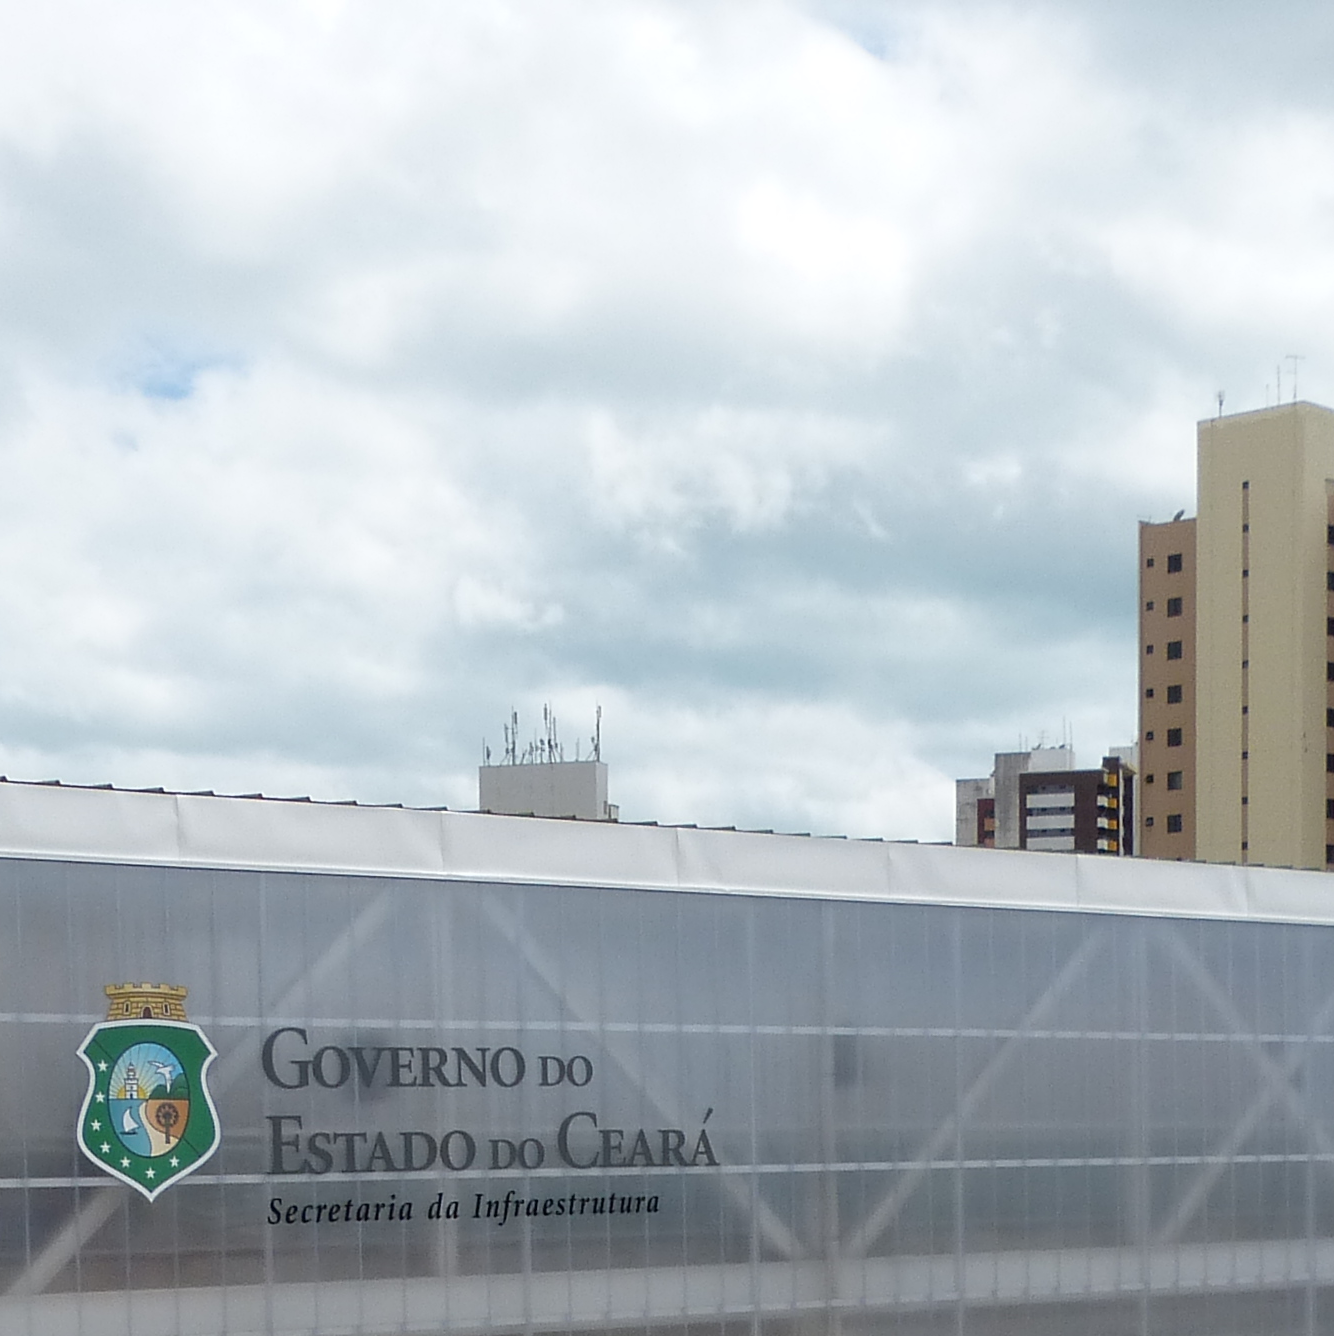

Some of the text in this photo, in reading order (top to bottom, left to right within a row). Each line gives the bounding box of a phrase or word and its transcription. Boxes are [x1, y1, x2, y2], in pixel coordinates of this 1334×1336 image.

[262, 1027, 594, 1090] GOVERNO DO
[265, 1108, 721, 1175] ESTADO DO CEARÁ
[267, 1191, 660, 1226] Secretaria da Infraestrutura
